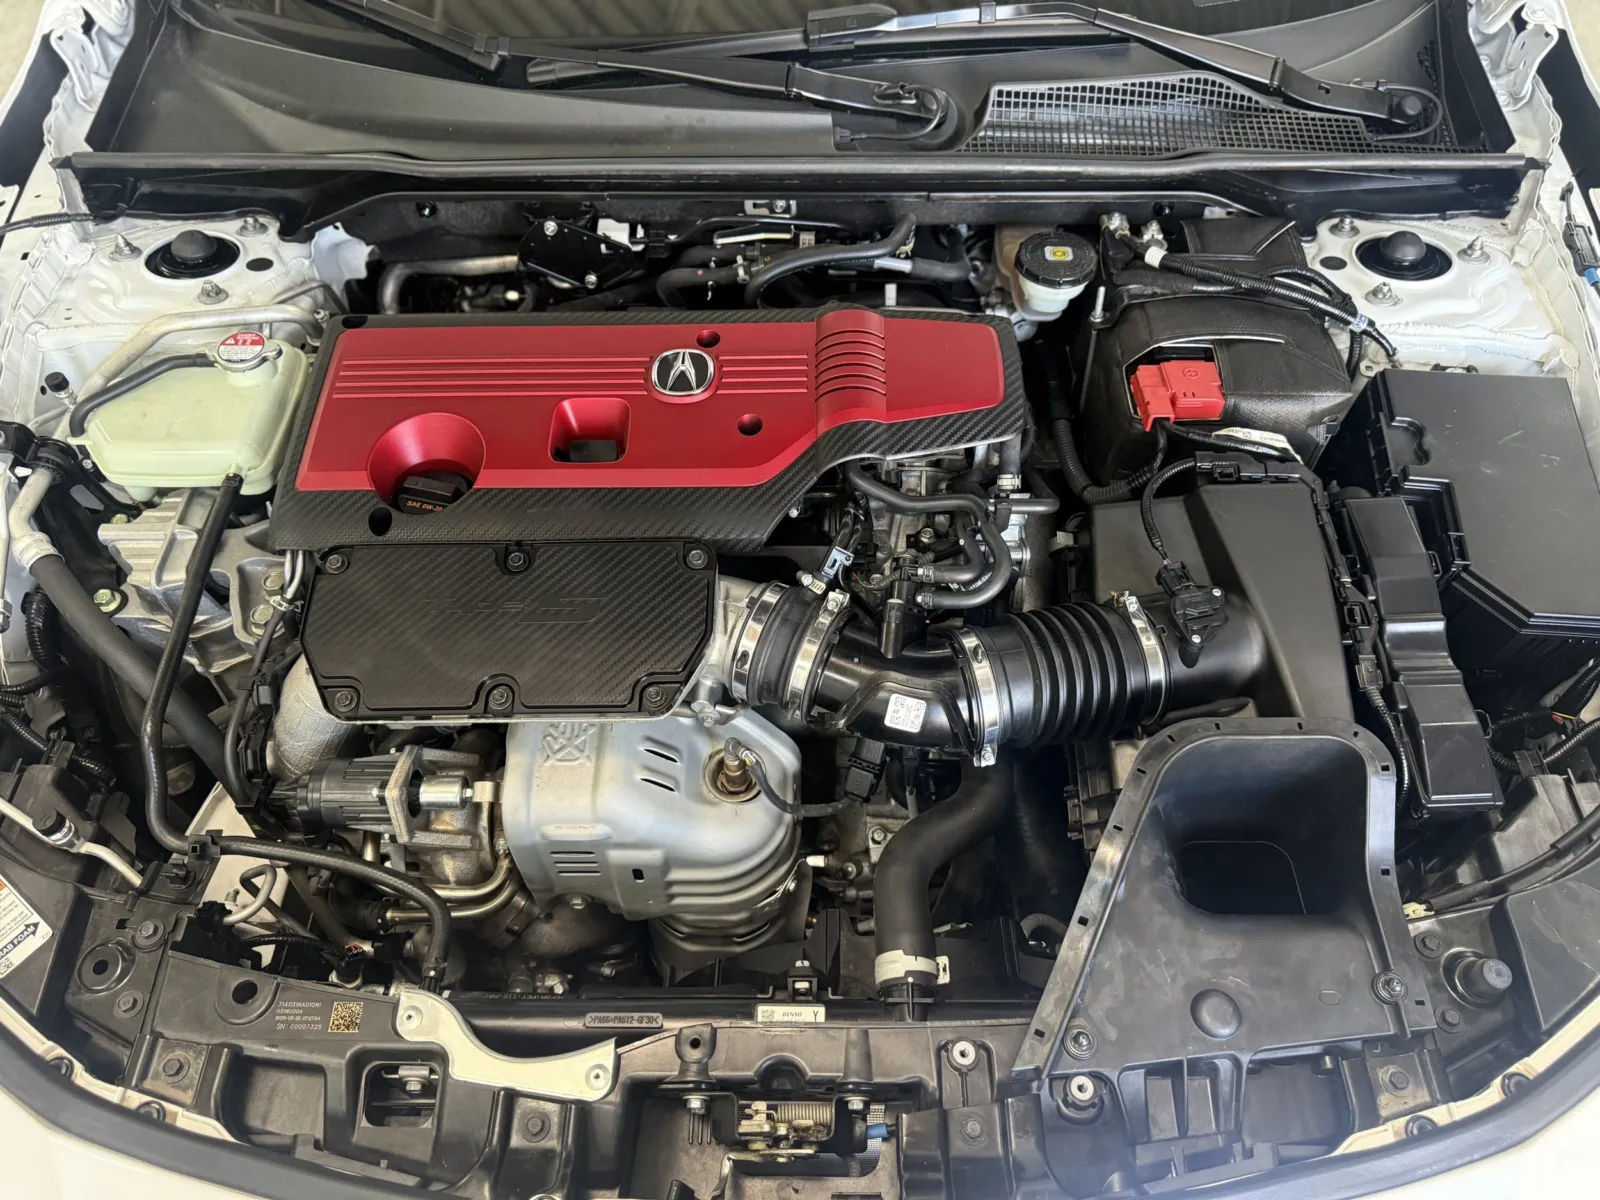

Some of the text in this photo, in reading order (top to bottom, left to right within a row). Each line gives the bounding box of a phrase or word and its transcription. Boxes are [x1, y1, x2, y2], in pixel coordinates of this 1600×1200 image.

[406, 500, 421, 508] SAE
[13, 925, 36, 945] FOAM
[812, 1009, 819, 1022] Y
[276, 1022, 288, 1030] SN:
